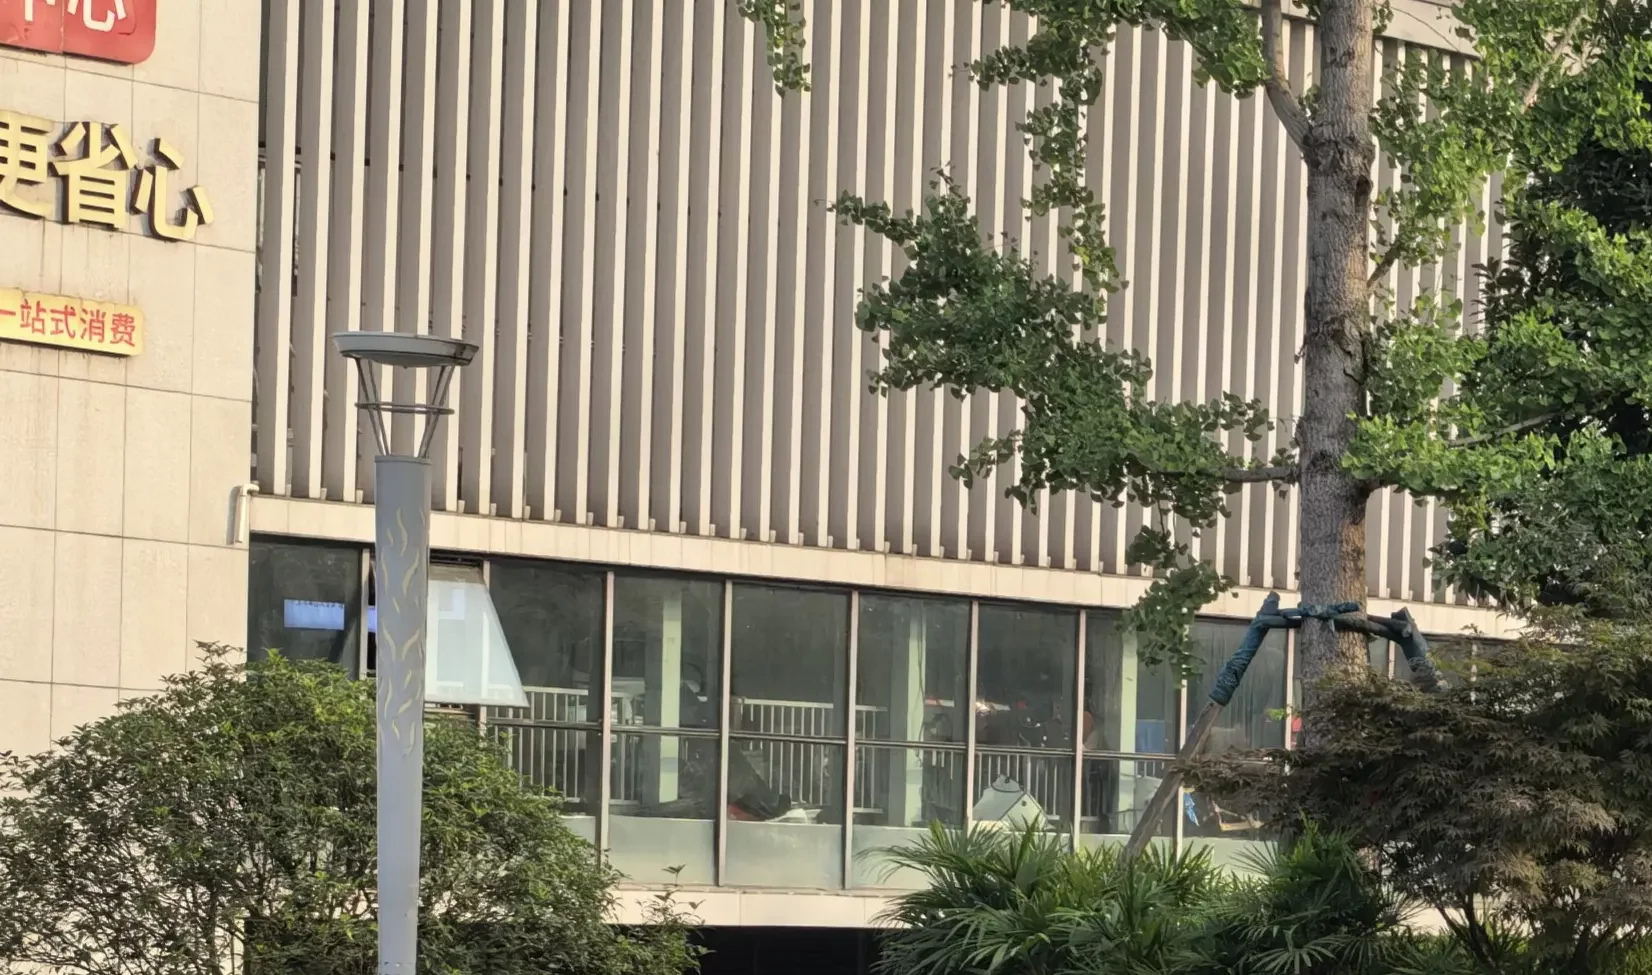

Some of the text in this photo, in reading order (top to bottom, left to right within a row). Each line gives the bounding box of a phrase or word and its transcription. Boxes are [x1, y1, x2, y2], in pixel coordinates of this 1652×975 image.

[0, 299, 137, 347] 一站式消费
